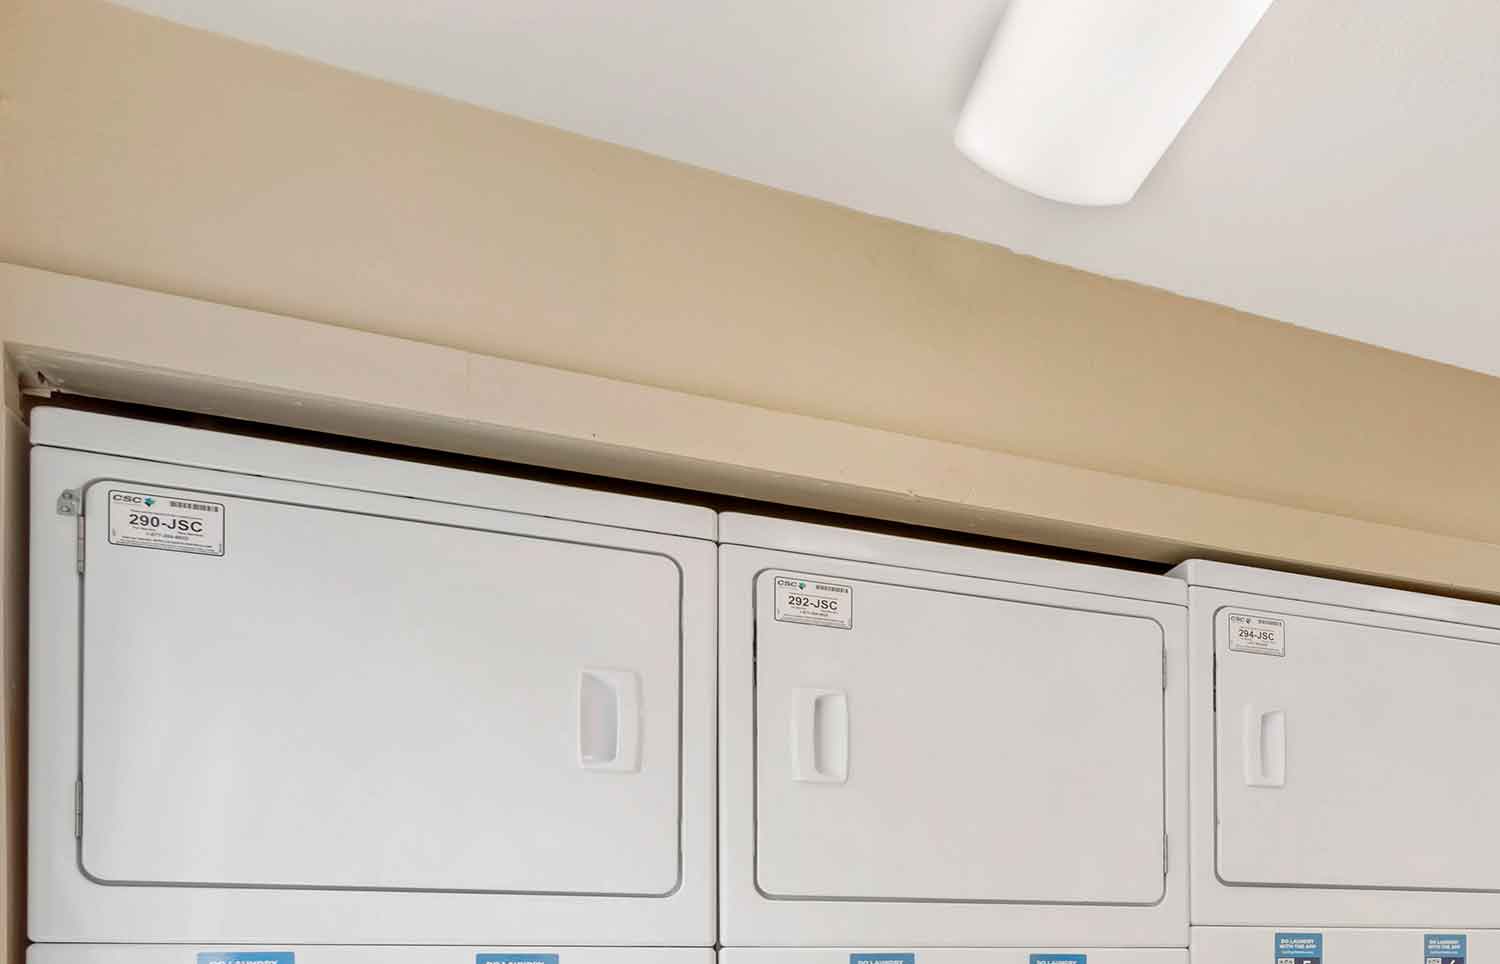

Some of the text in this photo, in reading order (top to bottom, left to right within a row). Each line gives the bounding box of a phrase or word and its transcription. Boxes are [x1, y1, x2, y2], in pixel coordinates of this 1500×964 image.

[112, 494, 142, 504] CSC
[129, 514, 203, 532] 290-JSC
[788, 595, 838, 610] 292-JSC
[1239, 629, 1274, 641] 294-JSC
